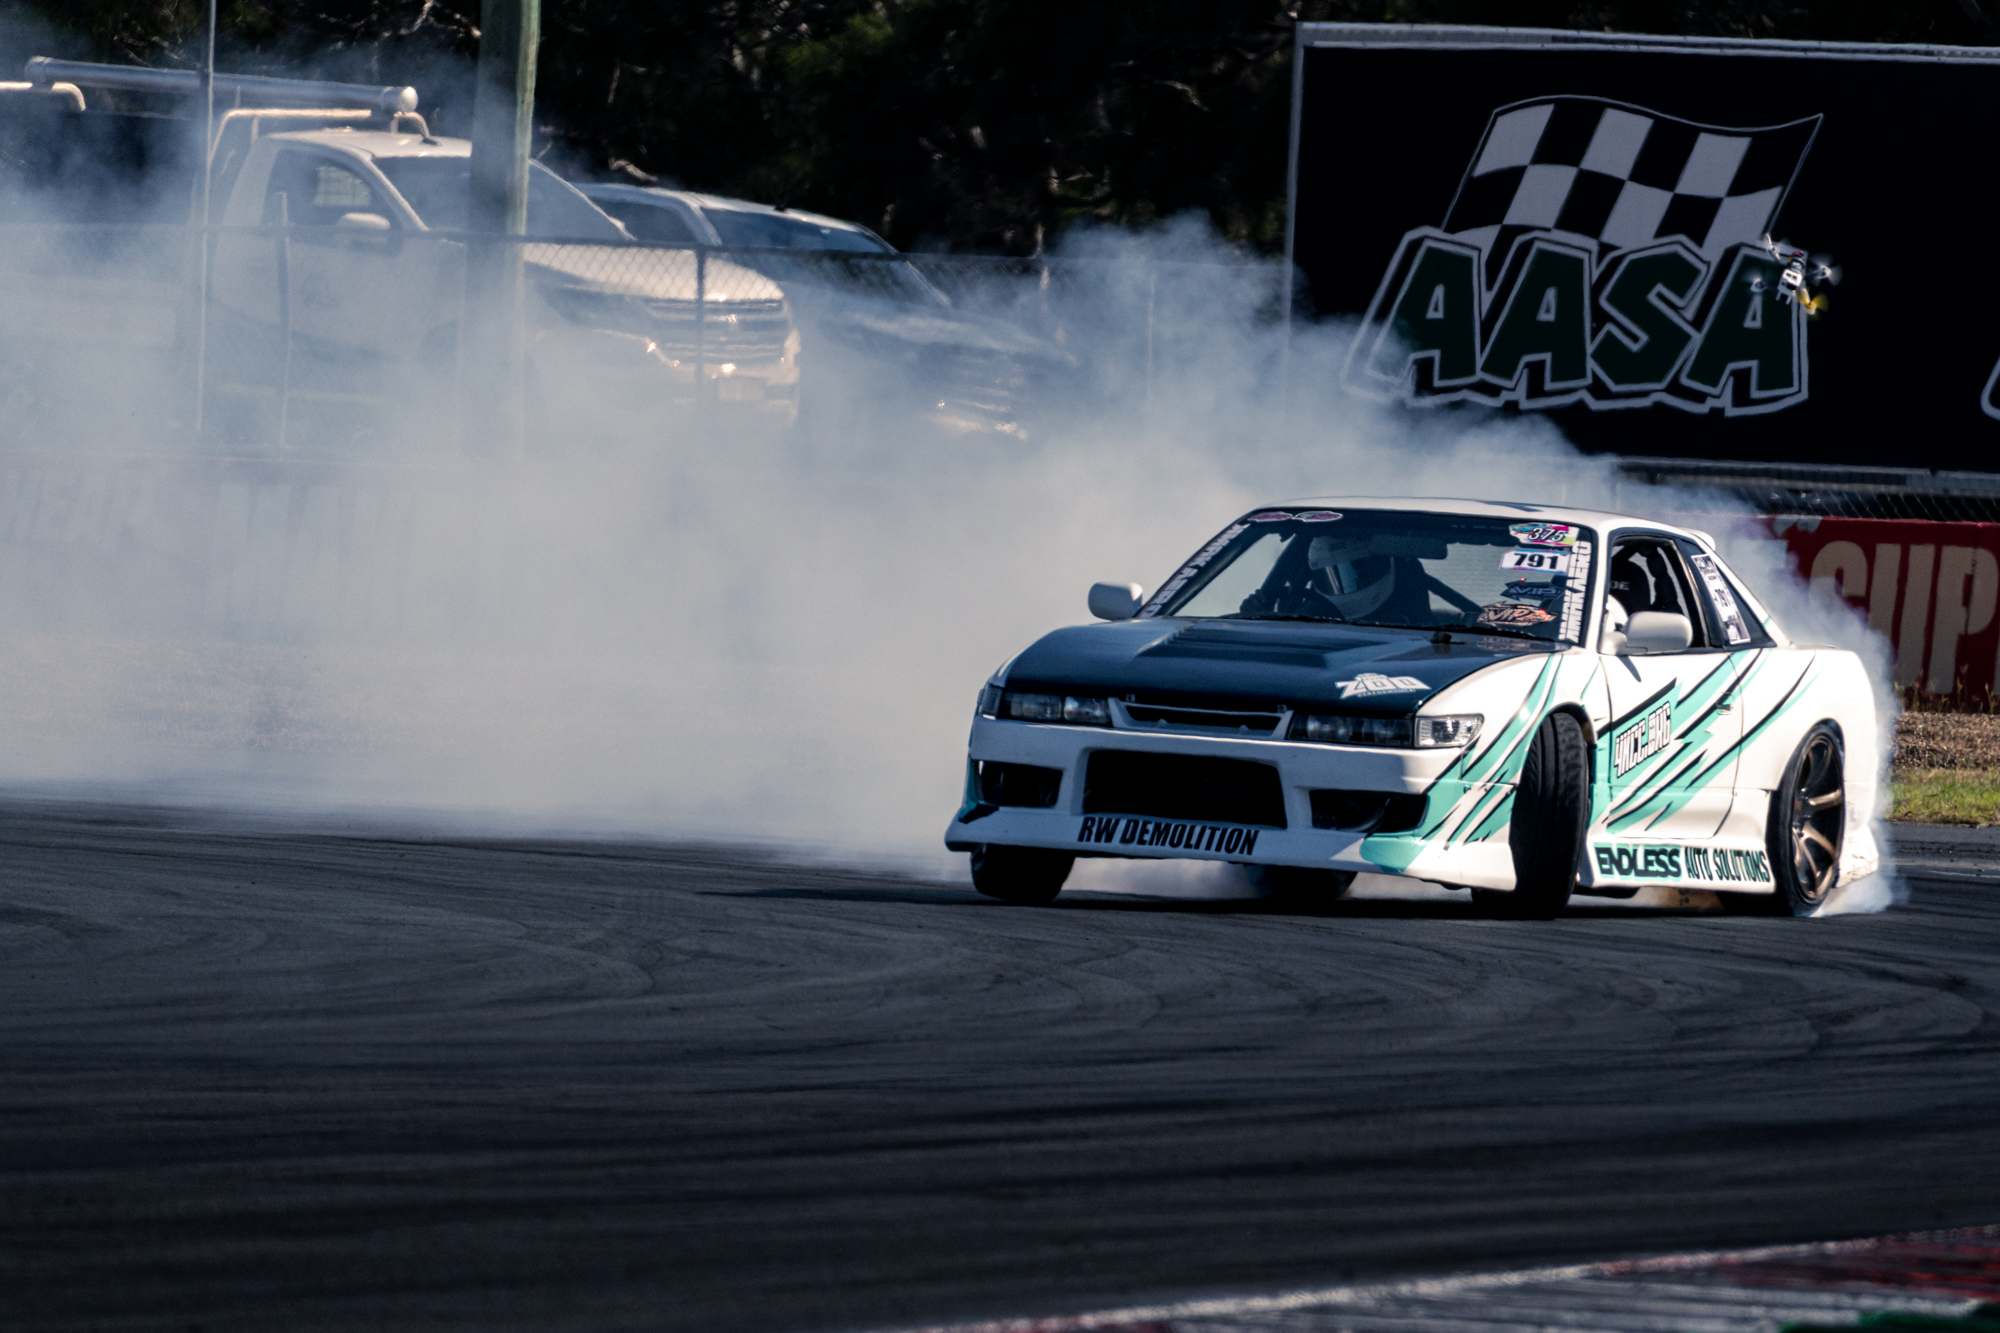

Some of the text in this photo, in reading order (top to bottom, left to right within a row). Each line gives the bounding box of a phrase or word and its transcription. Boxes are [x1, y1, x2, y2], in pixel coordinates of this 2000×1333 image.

[1347, 229, 1806, 413] AASA
[1528, 527, 1567, 542] 375
[1513, 552, 1559, 570] 791
[1511, 585, 1557, 595] VIP
[1809, 540, 2000, 693] SUP
[1335, 676, 1432, 699] ZOO
[1077, 816, 1260, 856] RW DEMOLITION
[1594, 845, 1771, 883] ENDLESS AUTO SOLUTIONS
